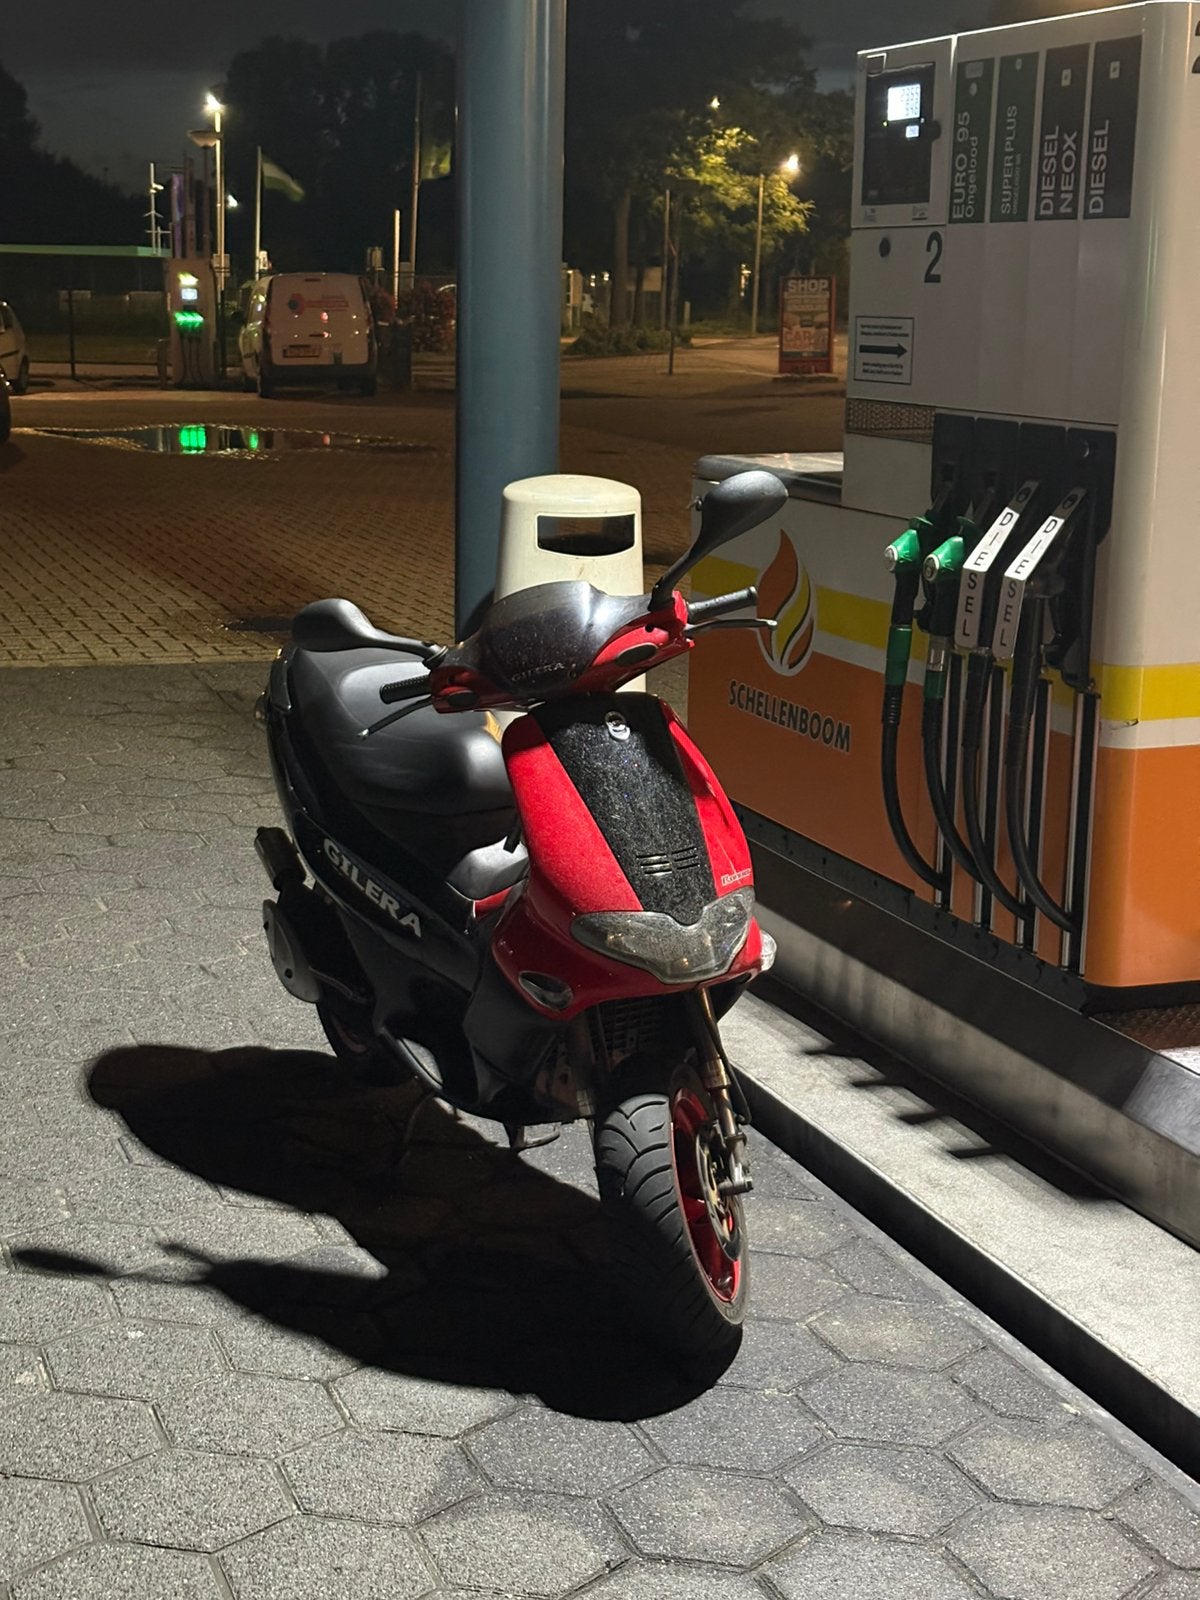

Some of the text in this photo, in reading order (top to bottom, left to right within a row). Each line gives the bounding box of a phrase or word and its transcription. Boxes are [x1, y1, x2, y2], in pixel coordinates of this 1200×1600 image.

[952, 112, 971, 219] EURO 95
[1004, 105, 1018, 152] PLUS
[1089, 119, 1110, 214] DIESEL
[965, 136, 978, 218] Ongelood
[1001, 155, 1014, 214] SUPER
[1039, 125, 1060, 216] DIESEL
[1059, 131, 1078, 213] NEOX
[788, 279, 829, 292] SHOP
[924, 231, 943, 283] 2
[962, 511, 1014, 637] DIESEL
[1000, 519, 1058, 647] DIESEL
[728, 680, 851, 752] SCHELLENBOOM
[323, 838, 422, 938] GILERA
